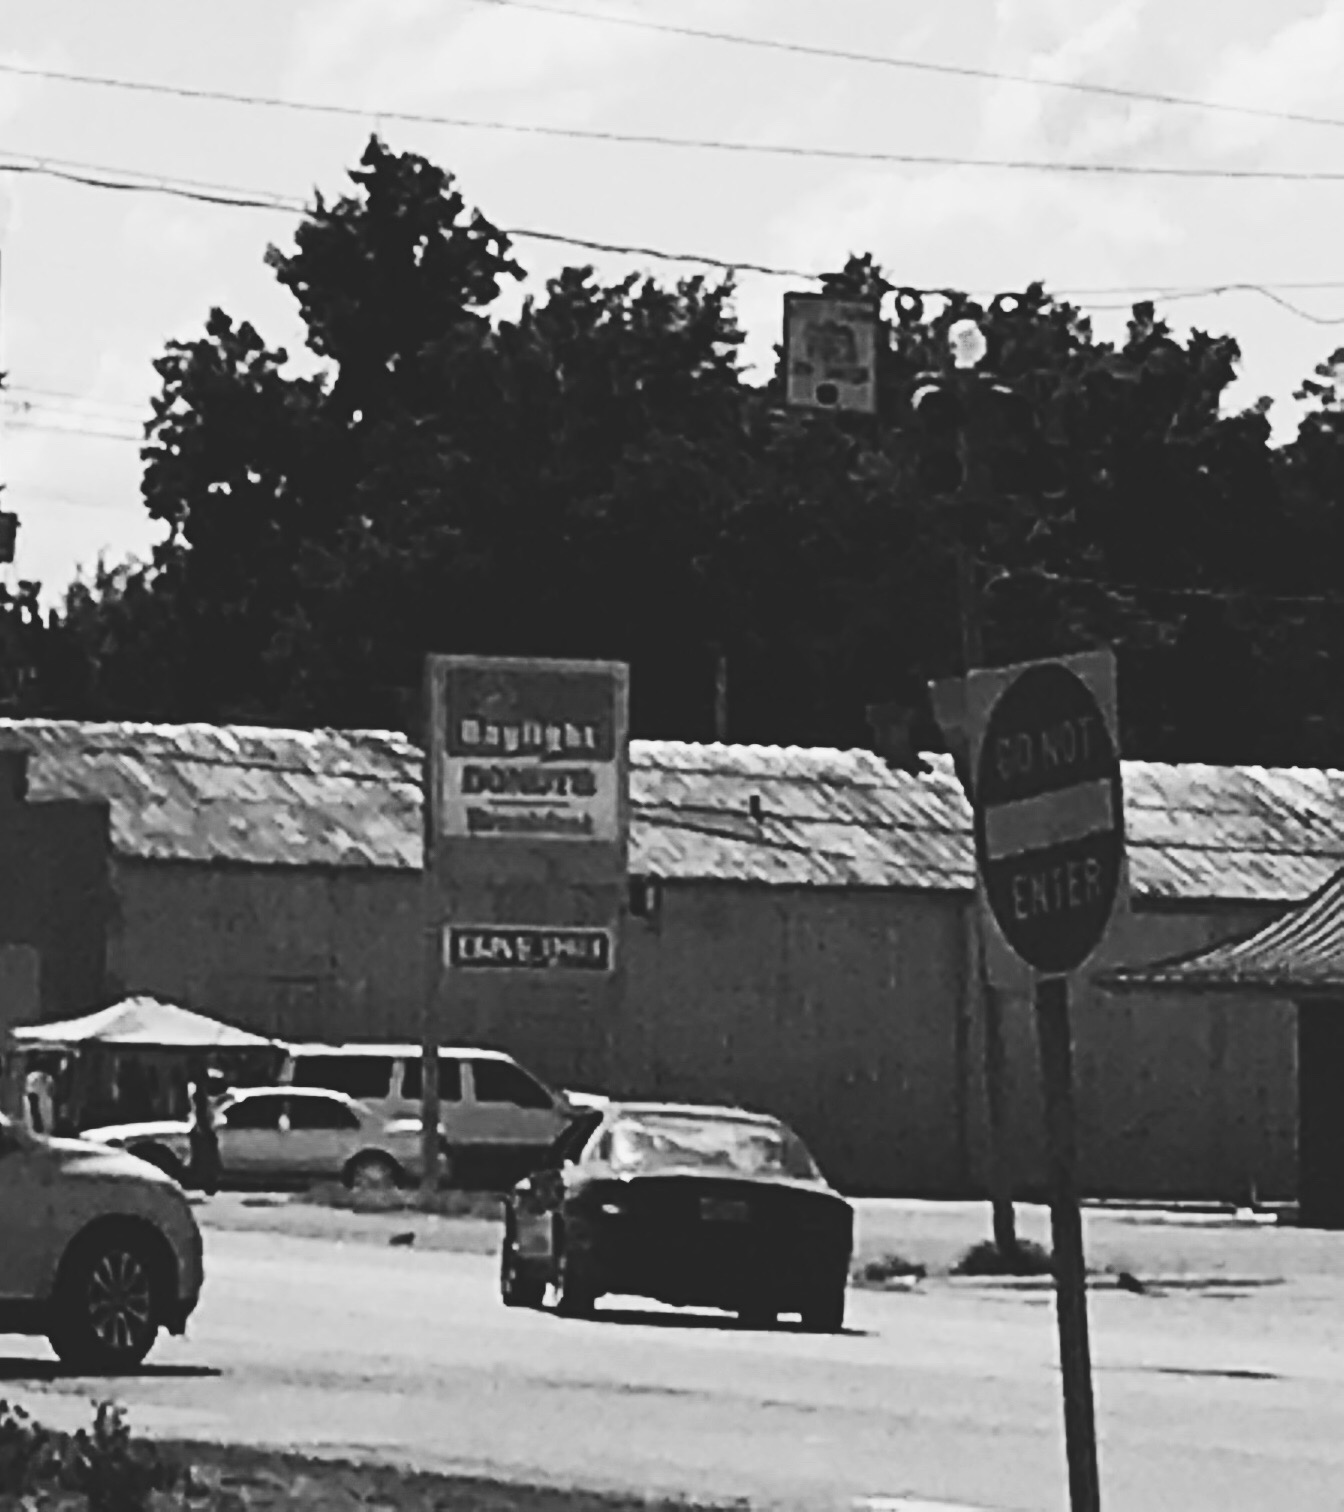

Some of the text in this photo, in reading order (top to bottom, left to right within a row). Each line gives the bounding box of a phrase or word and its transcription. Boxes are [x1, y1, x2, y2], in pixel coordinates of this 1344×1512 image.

[994, 716, 1095, 782] DO NOT
[1011, 856, 1103, 920] ENTER
